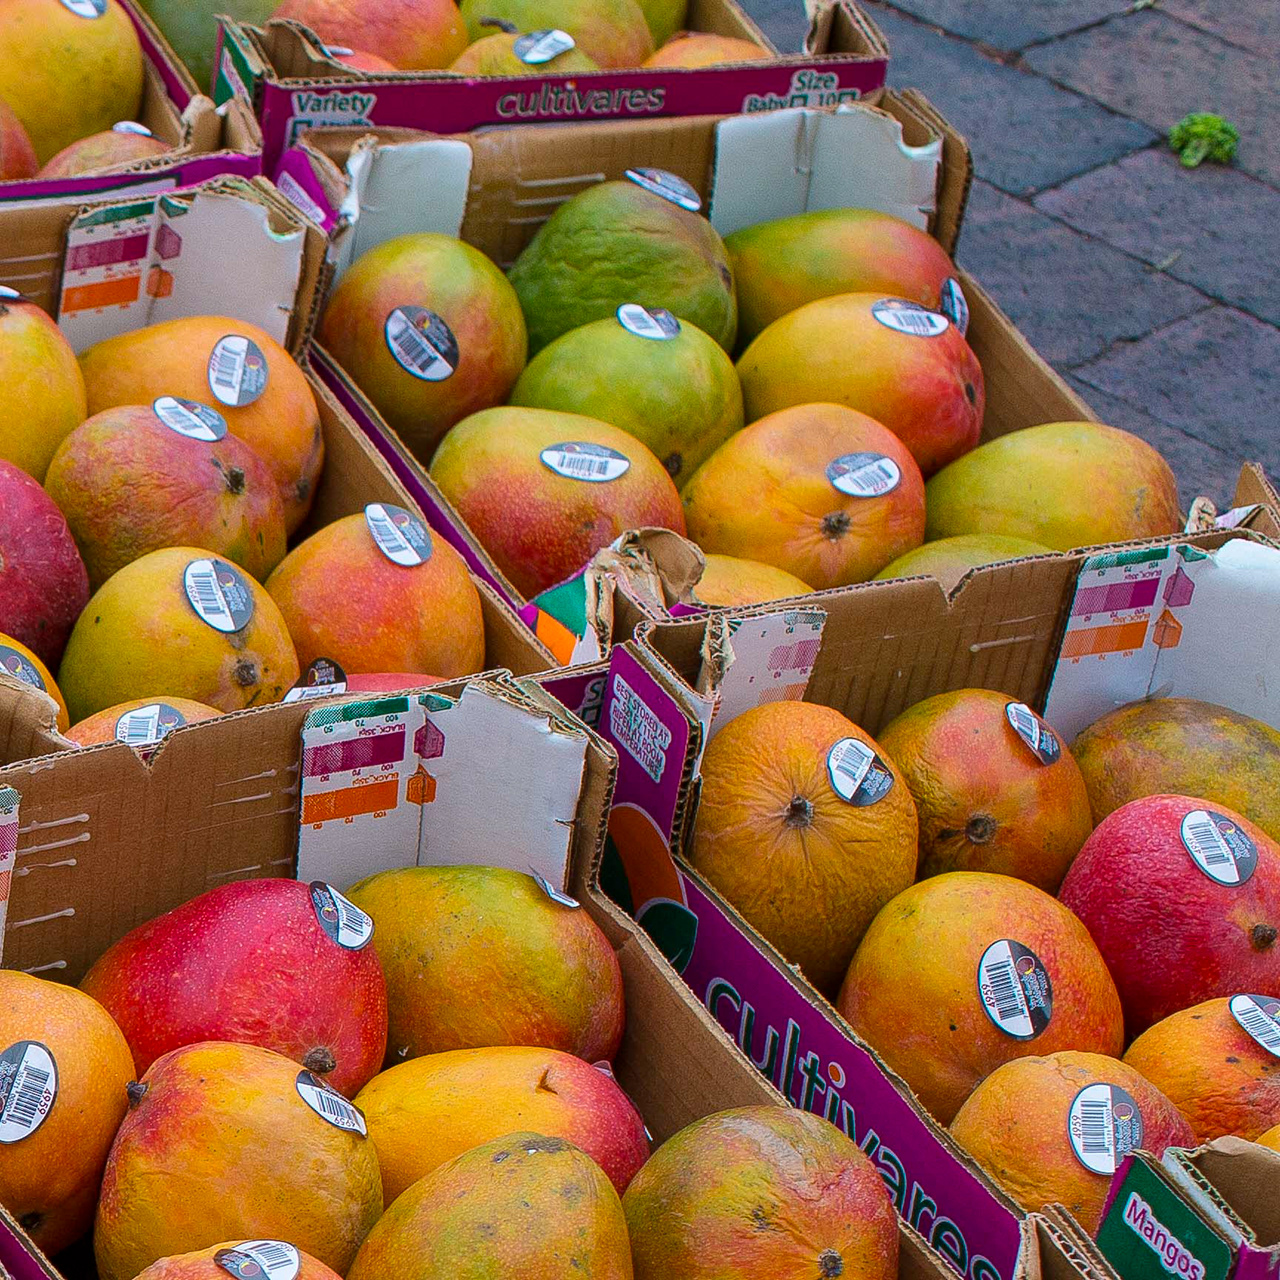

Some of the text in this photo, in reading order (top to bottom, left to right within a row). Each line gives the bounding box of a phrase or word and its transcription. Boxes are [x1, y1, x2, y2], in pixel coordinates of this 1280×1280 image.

[794, 70, 836, 93] Size
[296, 93, 374, 117] Variety
[497, 82, 666, 117] cultivares
[616, 681, 669, 744] BEST STORED AT
[981, 983, 995, 1008] 4959
[37, 1088, 51, 1115] 4959
[1072, 1115, 1081, 1138] 4959
